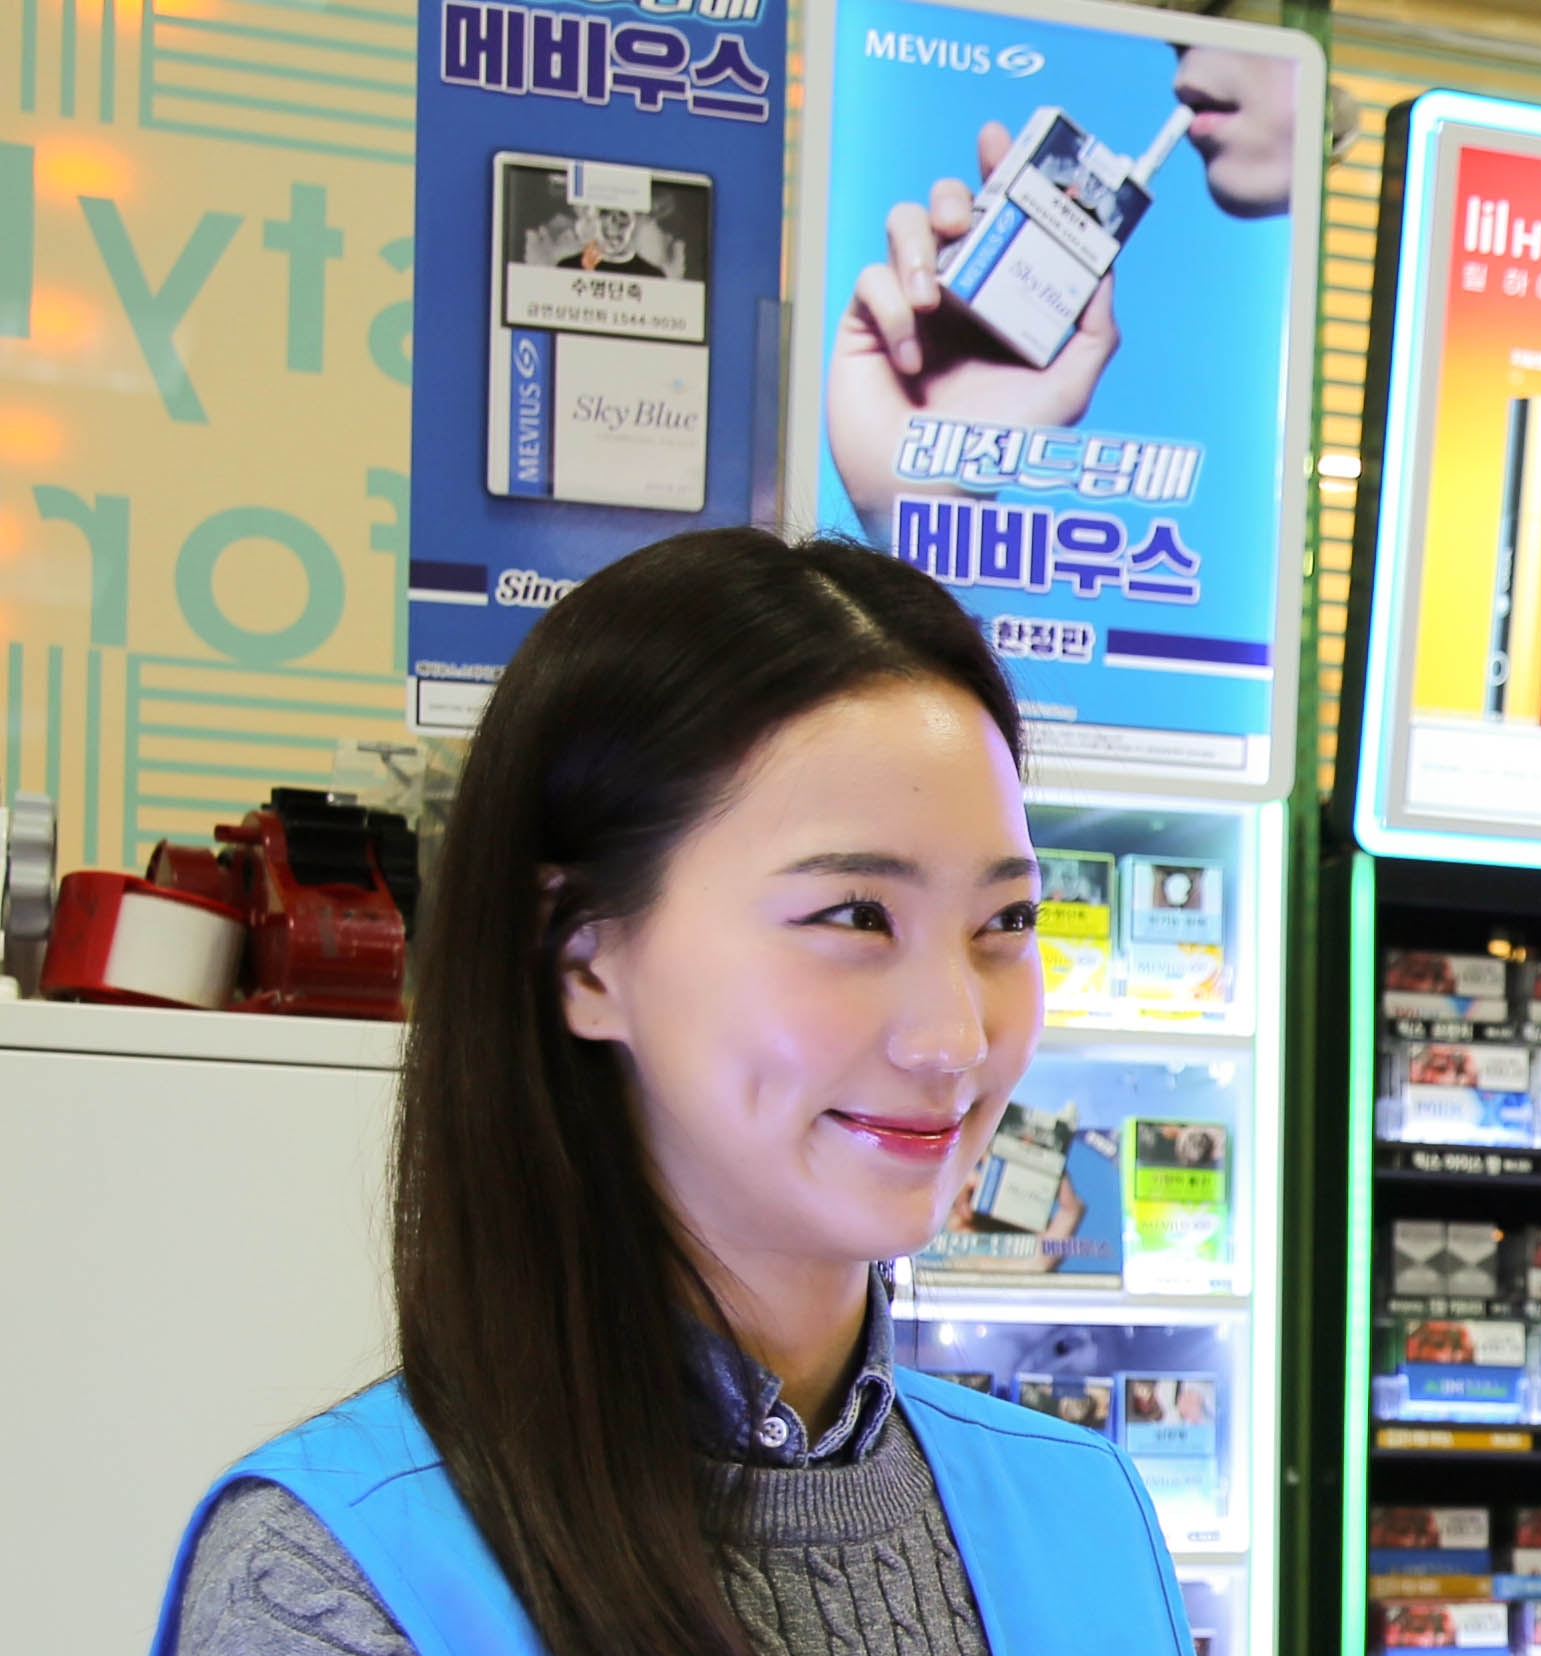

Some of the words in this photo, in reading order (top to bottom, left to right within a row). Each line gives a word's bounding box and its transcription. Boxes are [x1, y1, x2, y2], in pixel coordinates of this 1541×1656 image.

[441, 1, 768, 122] 메비우스
[864, 29, 991, 74] MEVIUS
[1464, 195, 1510, 256] lil
[613, 310, 687, 331] 1544-9030
[518, 383, 541, 482] MEVIUS
[572, 394, 630, 432] Sky
[633, 399, 698, 433] Blue
[897, 416, 1203, 503] 레전드담배
[895, 498, 1202, 603] 메비우스
